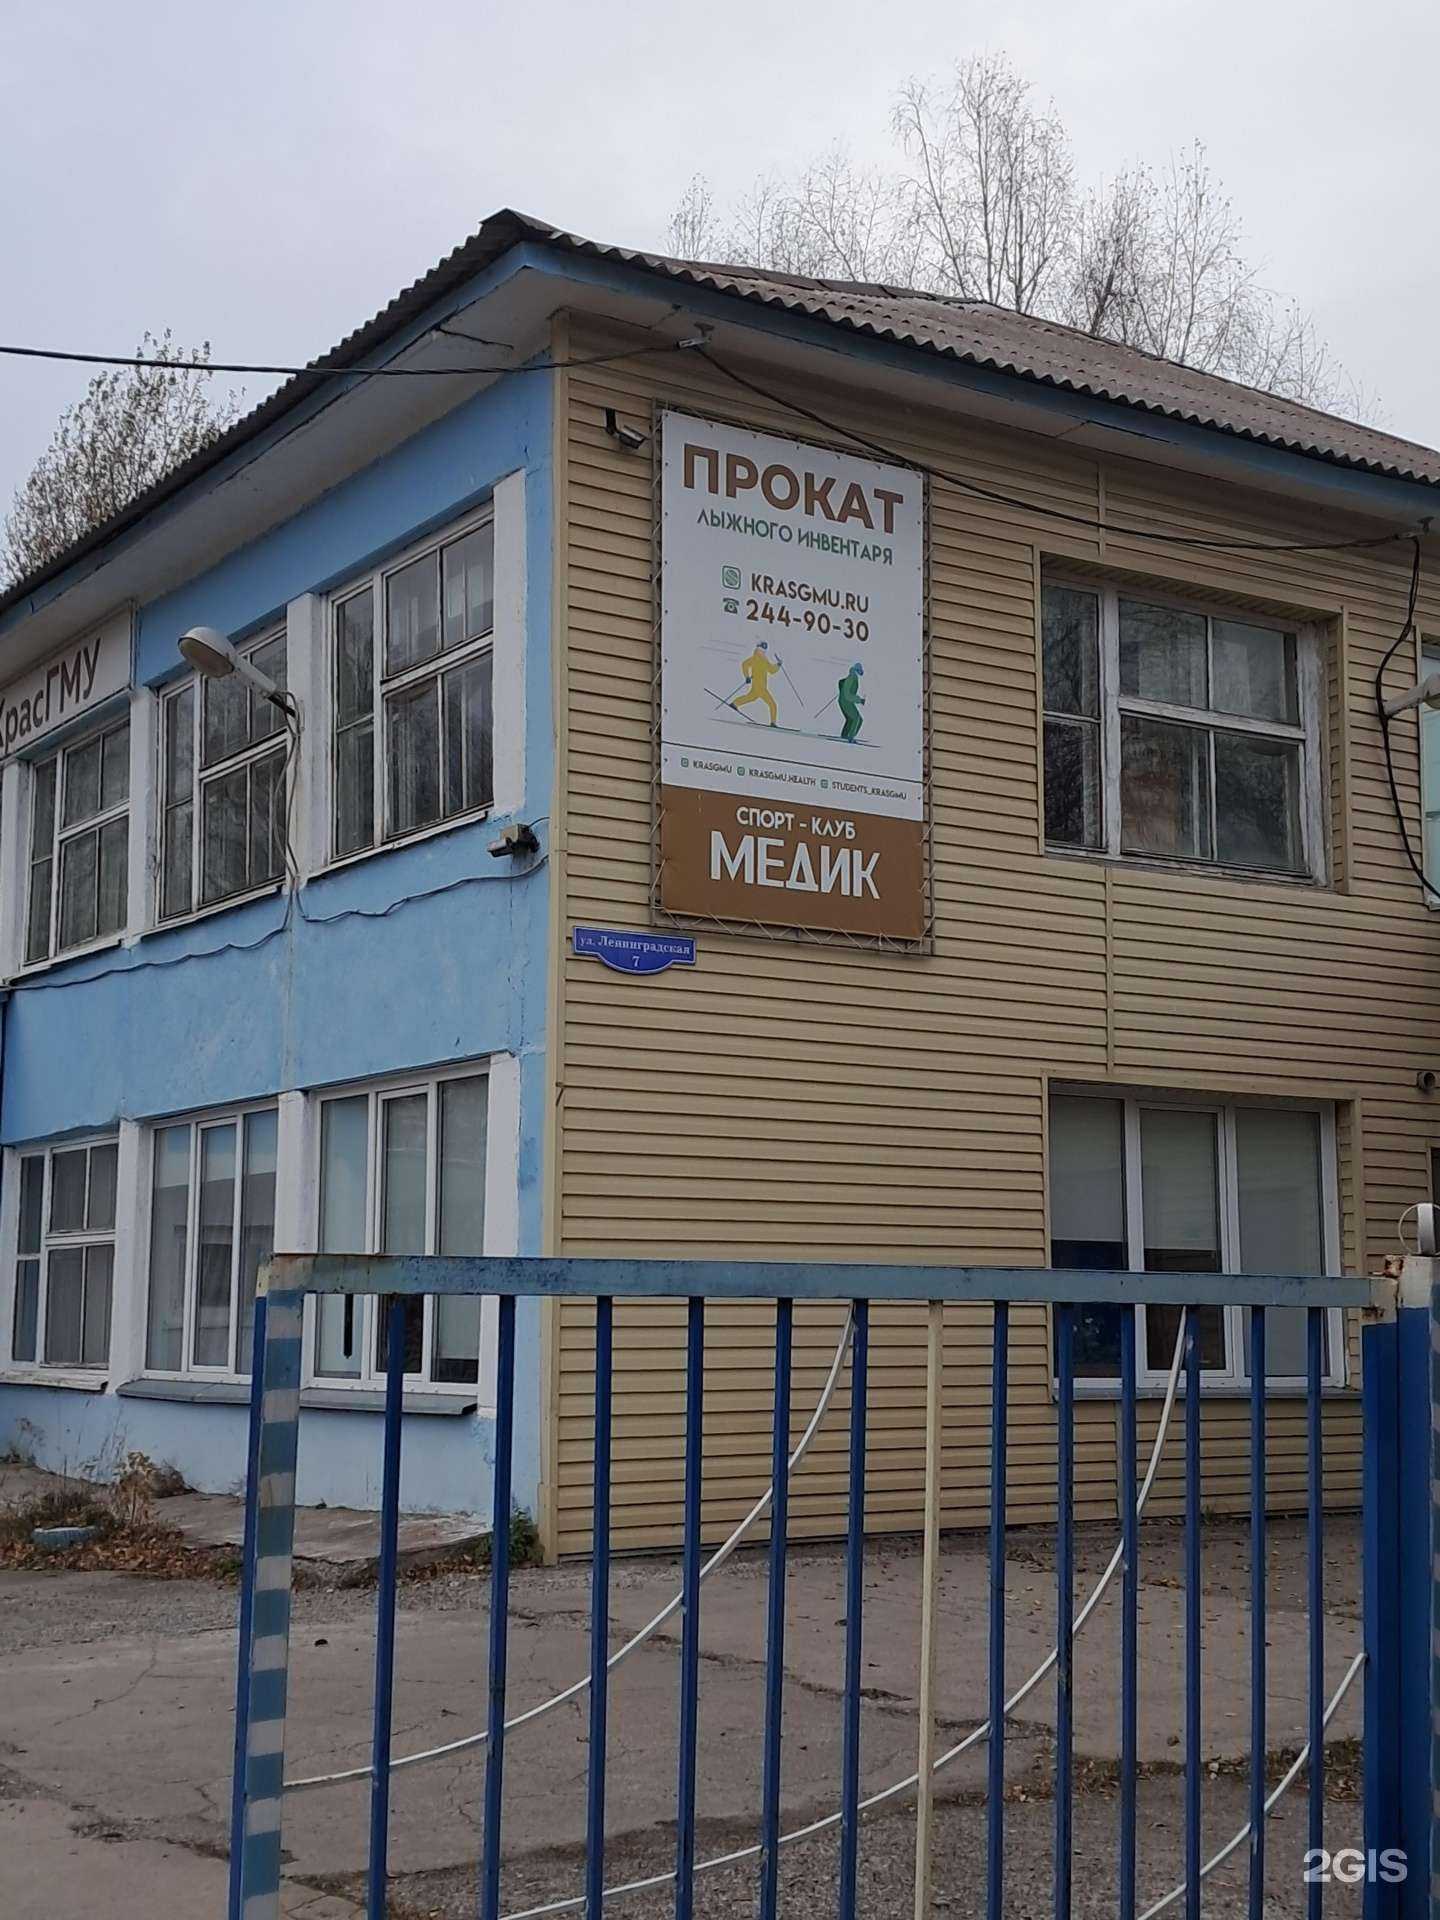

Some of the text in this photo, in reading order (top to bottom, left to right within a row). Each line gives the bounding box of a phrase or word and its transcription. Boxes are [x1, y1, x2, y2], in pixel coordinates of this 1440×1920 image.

[683, 443, 904, 534] ПРОКАТ
[697, 508, 893, 565] ЛЫЖНОГО ИНВЕНТАРЯ
[751, 573, 869, 613] KRASGMU.RU
[746, 599, 869, 642] 244-90-30
[0, 637, 101, 755] расГМУ
[693, 759, 733, 774] KRASGMU
[710, 830, 880, 900] МЕДИК
[580, 935, 690, 955] ул. Ленинградская
[631, 955, 641, 968] 7
